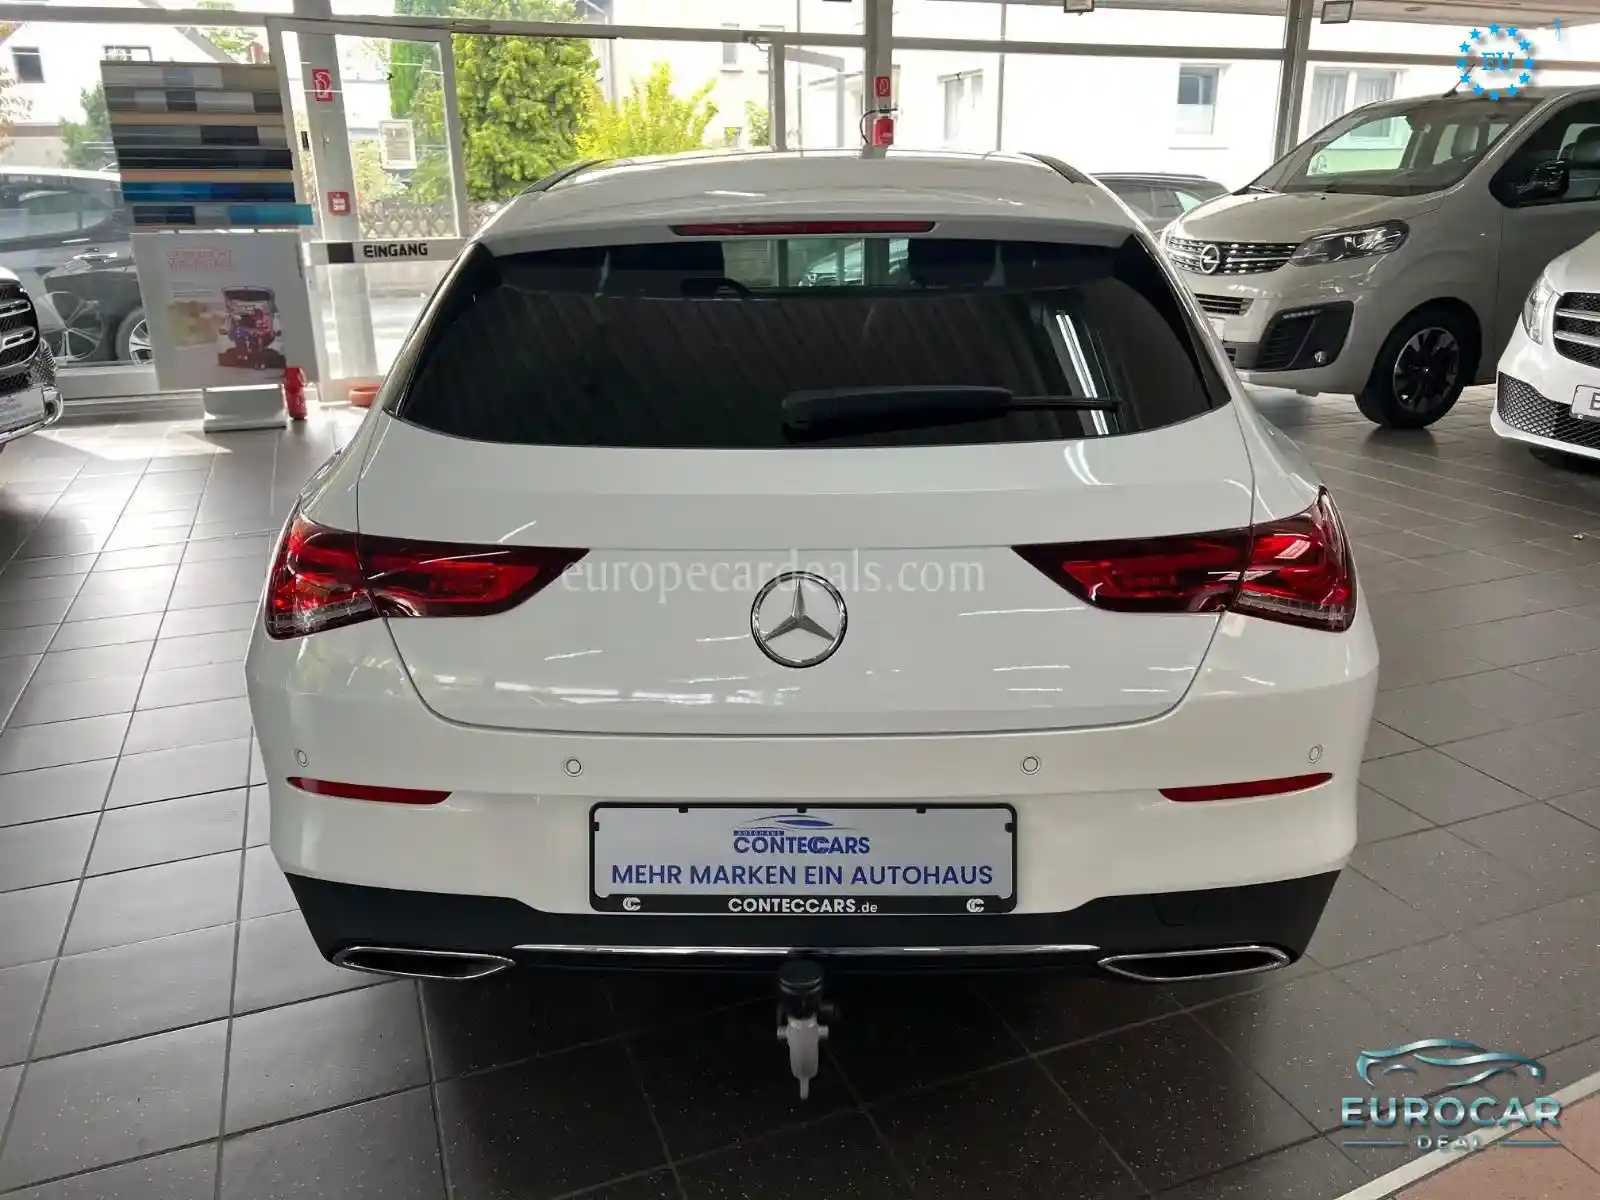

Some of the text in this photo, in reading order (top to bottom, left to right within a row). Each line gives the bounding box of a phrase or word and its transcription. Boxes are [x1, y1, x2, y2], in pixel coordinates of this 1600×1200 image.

[363, 242, 429, 259] EINGANG
[611, 864, 994, 886] MEHR MARKEN EIN AUTOHAUS
[727, 898, 879, 913] CONTECCARS.de
